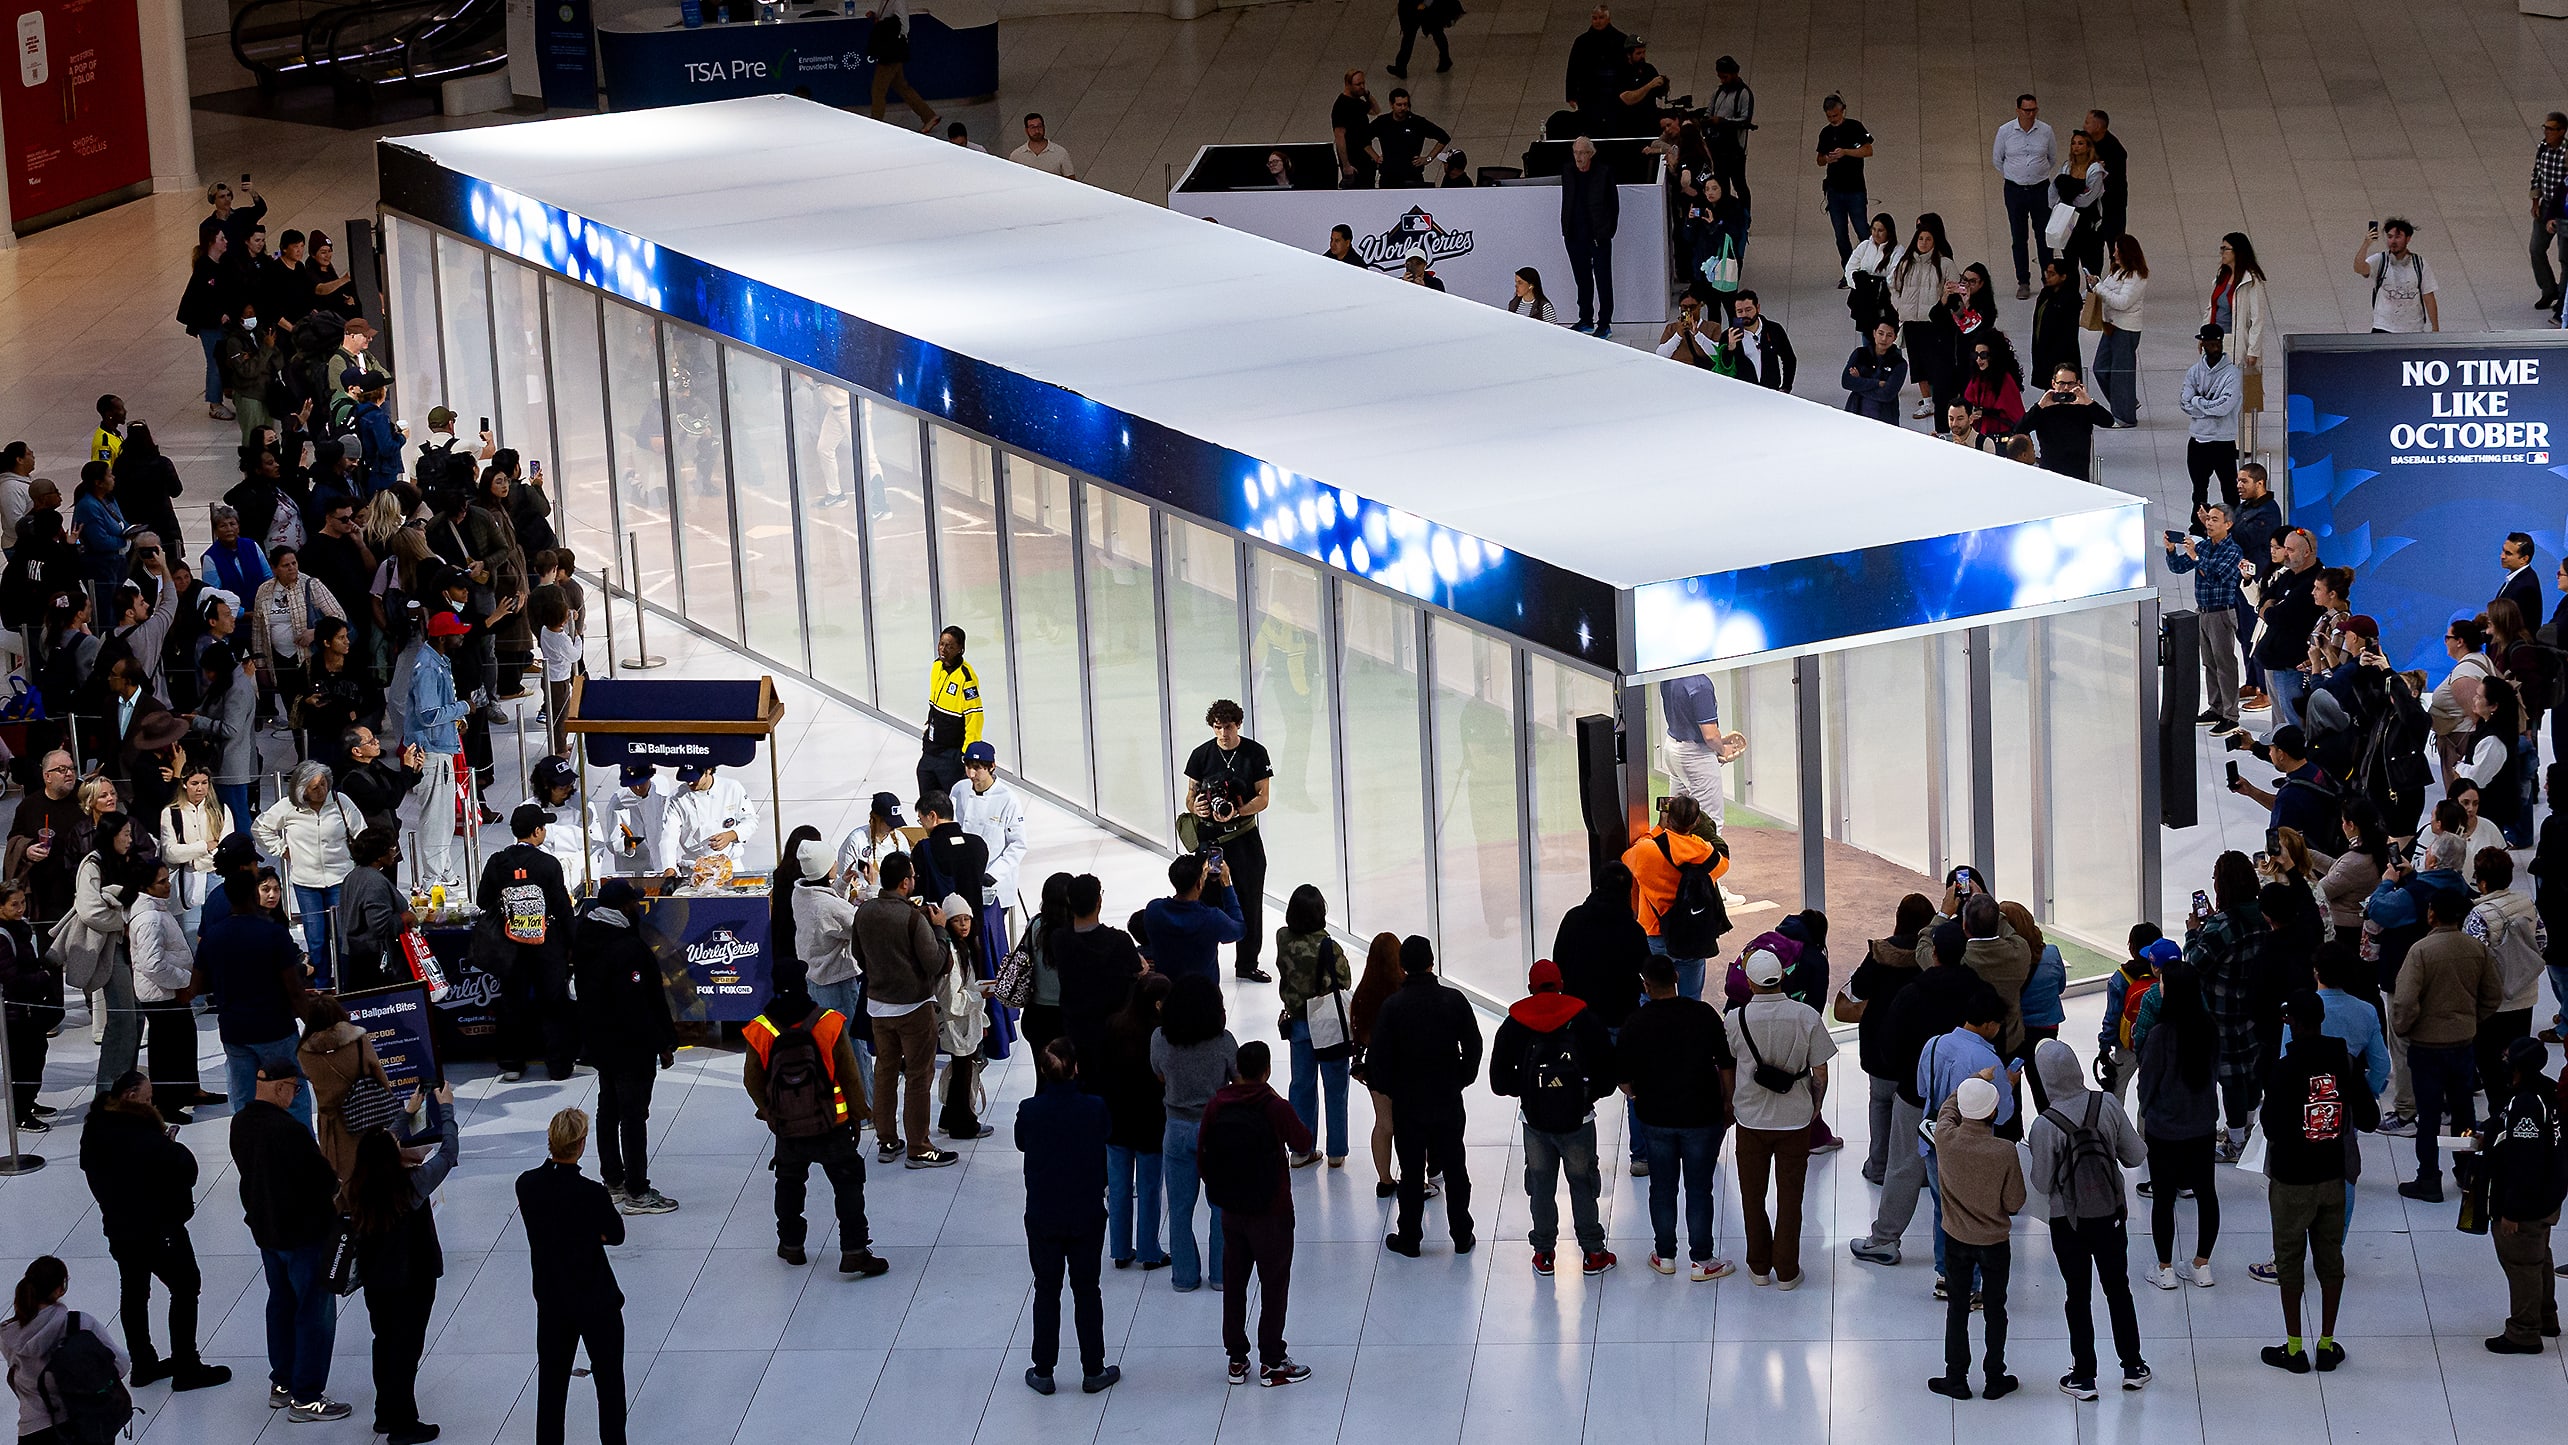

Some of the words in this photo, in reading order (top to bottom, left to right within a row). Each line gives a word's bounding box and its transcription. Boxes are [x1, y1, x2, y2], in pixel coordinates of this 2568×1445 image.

[74, 62, 88, 74] POP
[88, 59, 97, 71] OF
[798, 54, 834, 64] Enrollment
[798, 62, 828, 71] Provided
[73, 71, 95, 86] COLOR
[684, 60, 727, 83] TSA
[731, 59, 767, 79] Pre
[72, 134, 94, 150] SHOPS
[81, 140, 108, 157] OCULUS
[2402, 360, 2450, 387] NO
[2456, 359, 2540, 386] TIME
[2431, 391, 2509, 417] LIKE
[2389, 422, 2551, 449] OCTOBER
[2390, 455, 2437, 465] BASEBALL
[2437, 455, 2447, 465] IS
[2447, 454, 2502, 464] SOMETHING
[2502, 454, 2526, 463] ELSE
[647, 744, 686, 756] Ballpark
[686, 744, 710, 755] Bites
[527, 916, 542, 927] York
[445, 975, 482, 1001] orld
[696, 985, 715, 994] FOX
[361, 1004, 397, 1019] Ballpark
[395, 1001, 417, 1014] Bites
[380, 1028, 396, 1038] DOG
[389, 1054, 406, 1064] DOG
